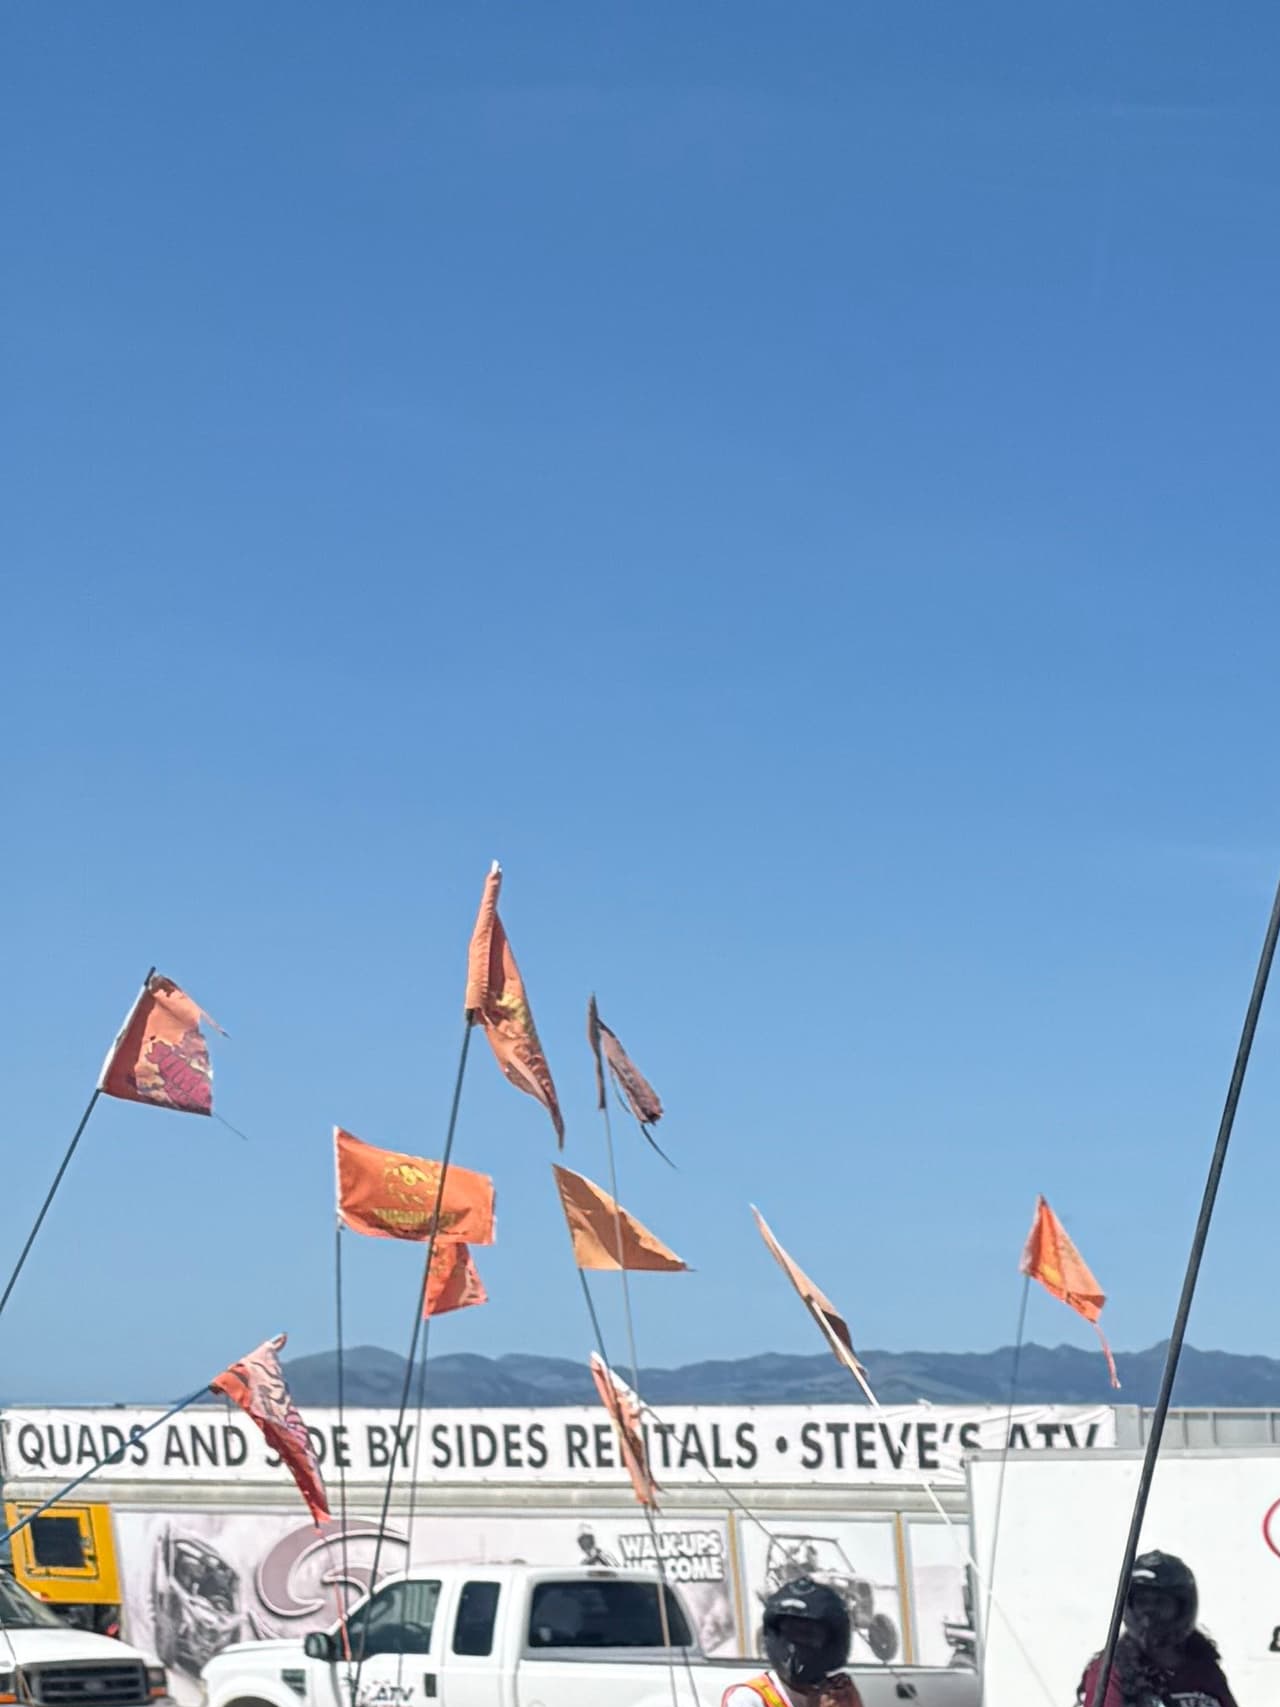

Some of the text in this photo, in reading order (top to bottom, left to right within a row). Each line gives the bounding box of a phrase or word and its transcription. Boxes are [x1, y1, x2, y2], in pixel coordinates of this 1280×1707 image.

[18, 1424, 149, 1469] QUADS
[164, 1425, 248, 1467] AND
[367, 1425, 415, 1467] BY
[432, 1423, 548, 1468] SIDES
